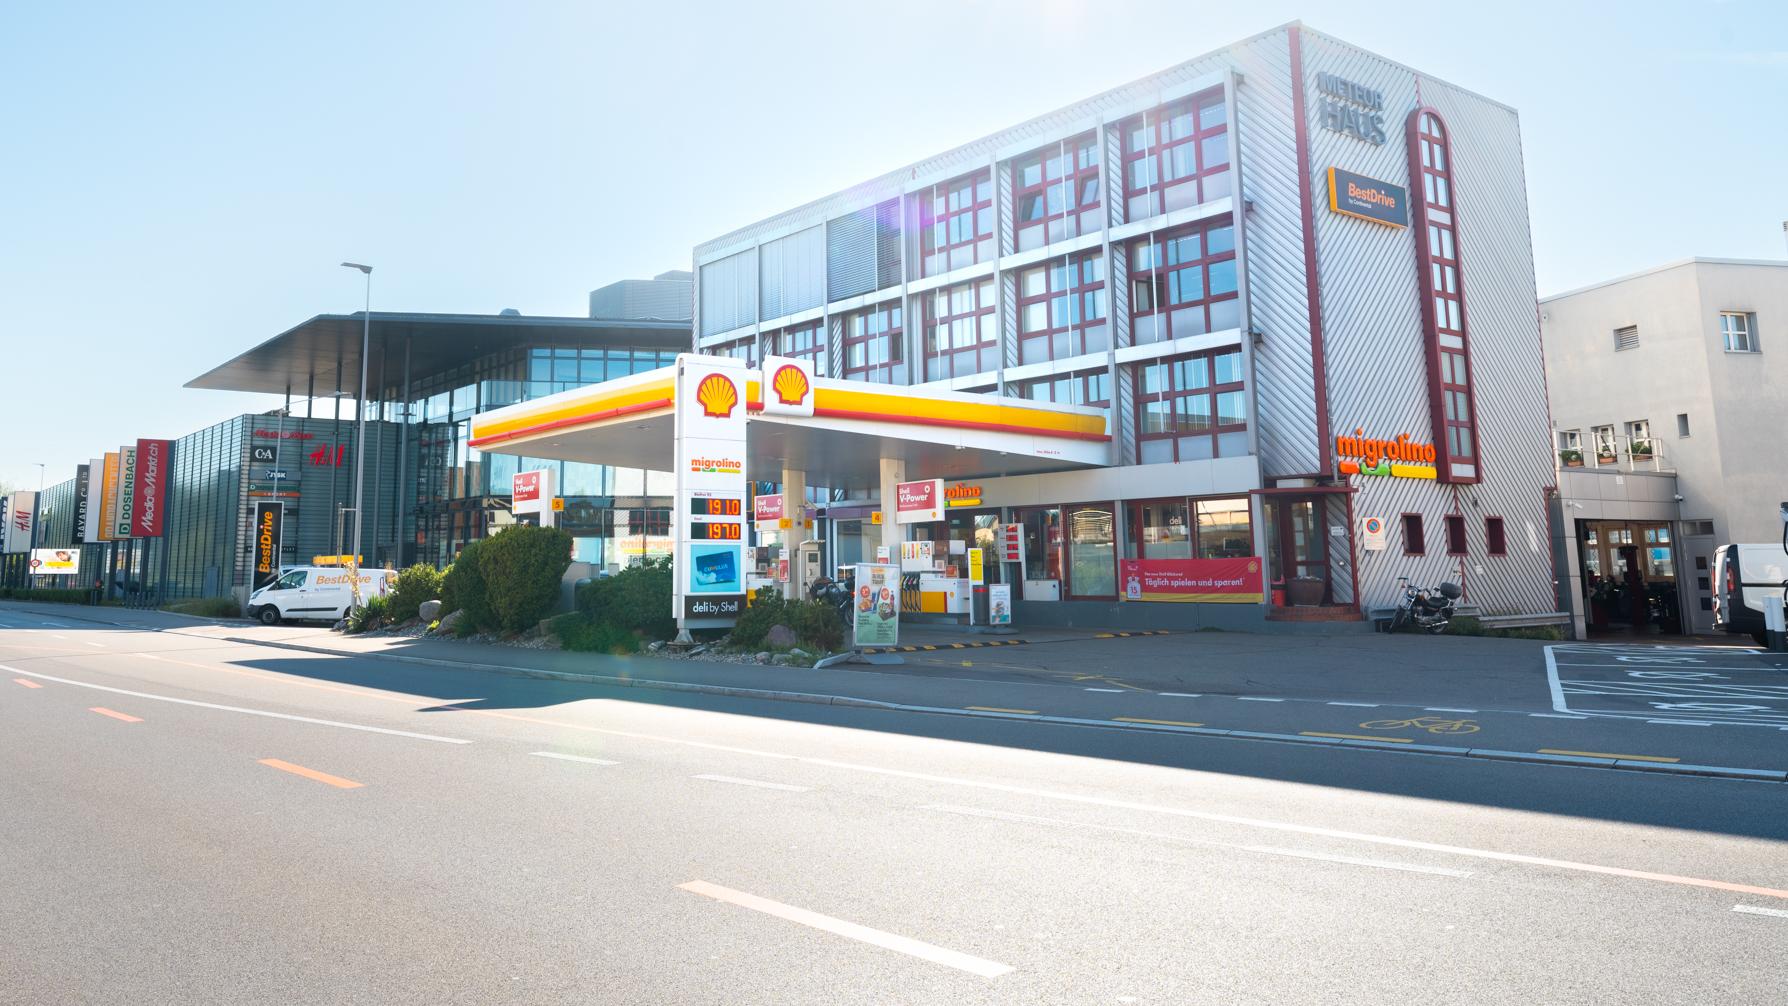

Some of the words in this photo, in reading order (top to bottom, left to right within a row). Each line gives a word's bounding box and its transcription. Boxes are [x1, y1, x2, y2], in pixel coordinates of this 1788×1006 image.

[1318, 71, 1383, 112] METEOR
[1319, 96, 1387, 146] HAUS
[1348, 182, 1396, 209] BestDrive
[1337, 427, 1437, 468] migrolino
[691, 456, 742, 470] migrolino
[122, 449, 136, 521] DOSENBACH
[555, 501, 561, 509] 5
[900, 494, 929, 503] V-Power
[708, 499, 740, 515] 191.0
[757, 505, 781, 514] V-Power
[708, 523, 740, 539] 197.0
[258, 511, 273, 574] BestDrive
[1144, 578, 1169, 588] Täglich
[1170, 579, 1197, 588] spielen
[1198, 578, 1213, 587] und
[692, 601, 709, 613] deli
[709, 601, 719, 615] by
[720, 601, 738, 612] Shell
